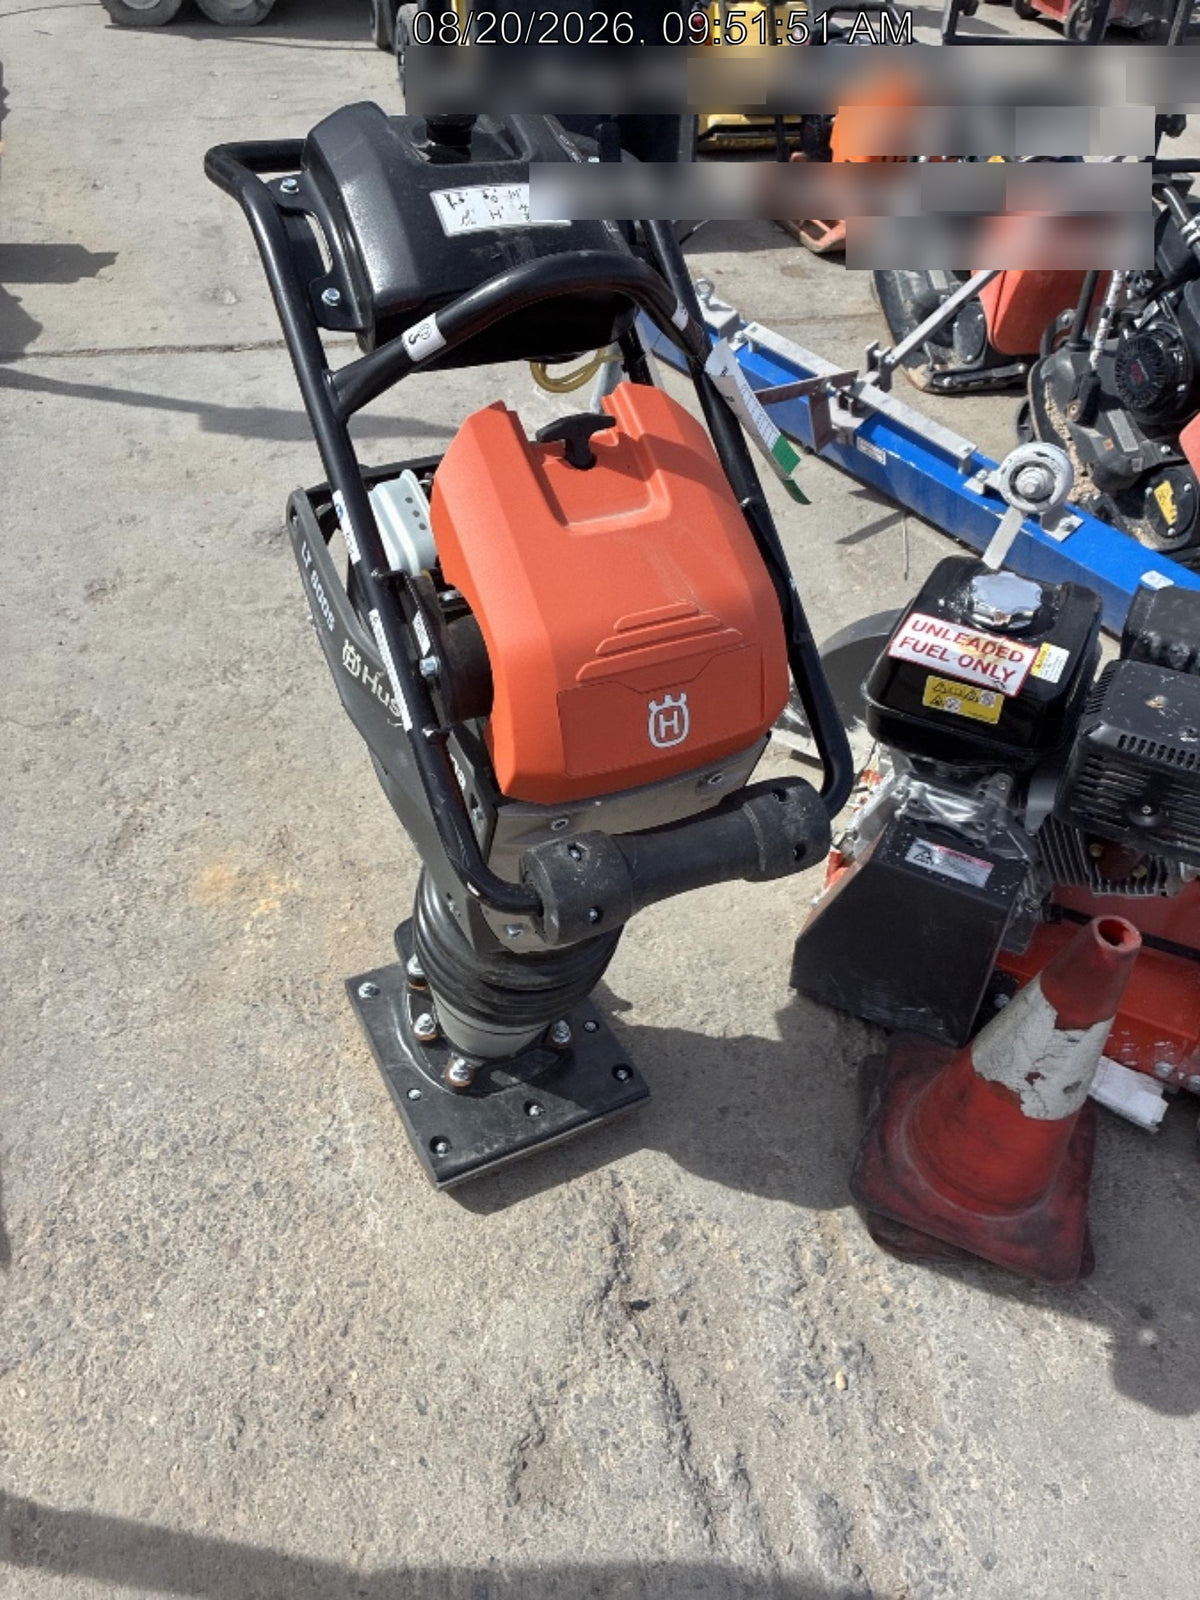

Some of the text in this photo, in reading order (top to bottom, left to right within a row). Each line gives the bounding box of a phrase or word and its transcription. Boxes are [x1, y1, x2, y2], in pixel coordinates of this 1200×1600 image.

[898, 635, 950, 662] FUEL
[957, 654, 1016, 684] ONLY
[911, 619, 1024, 663] UNLEADED
